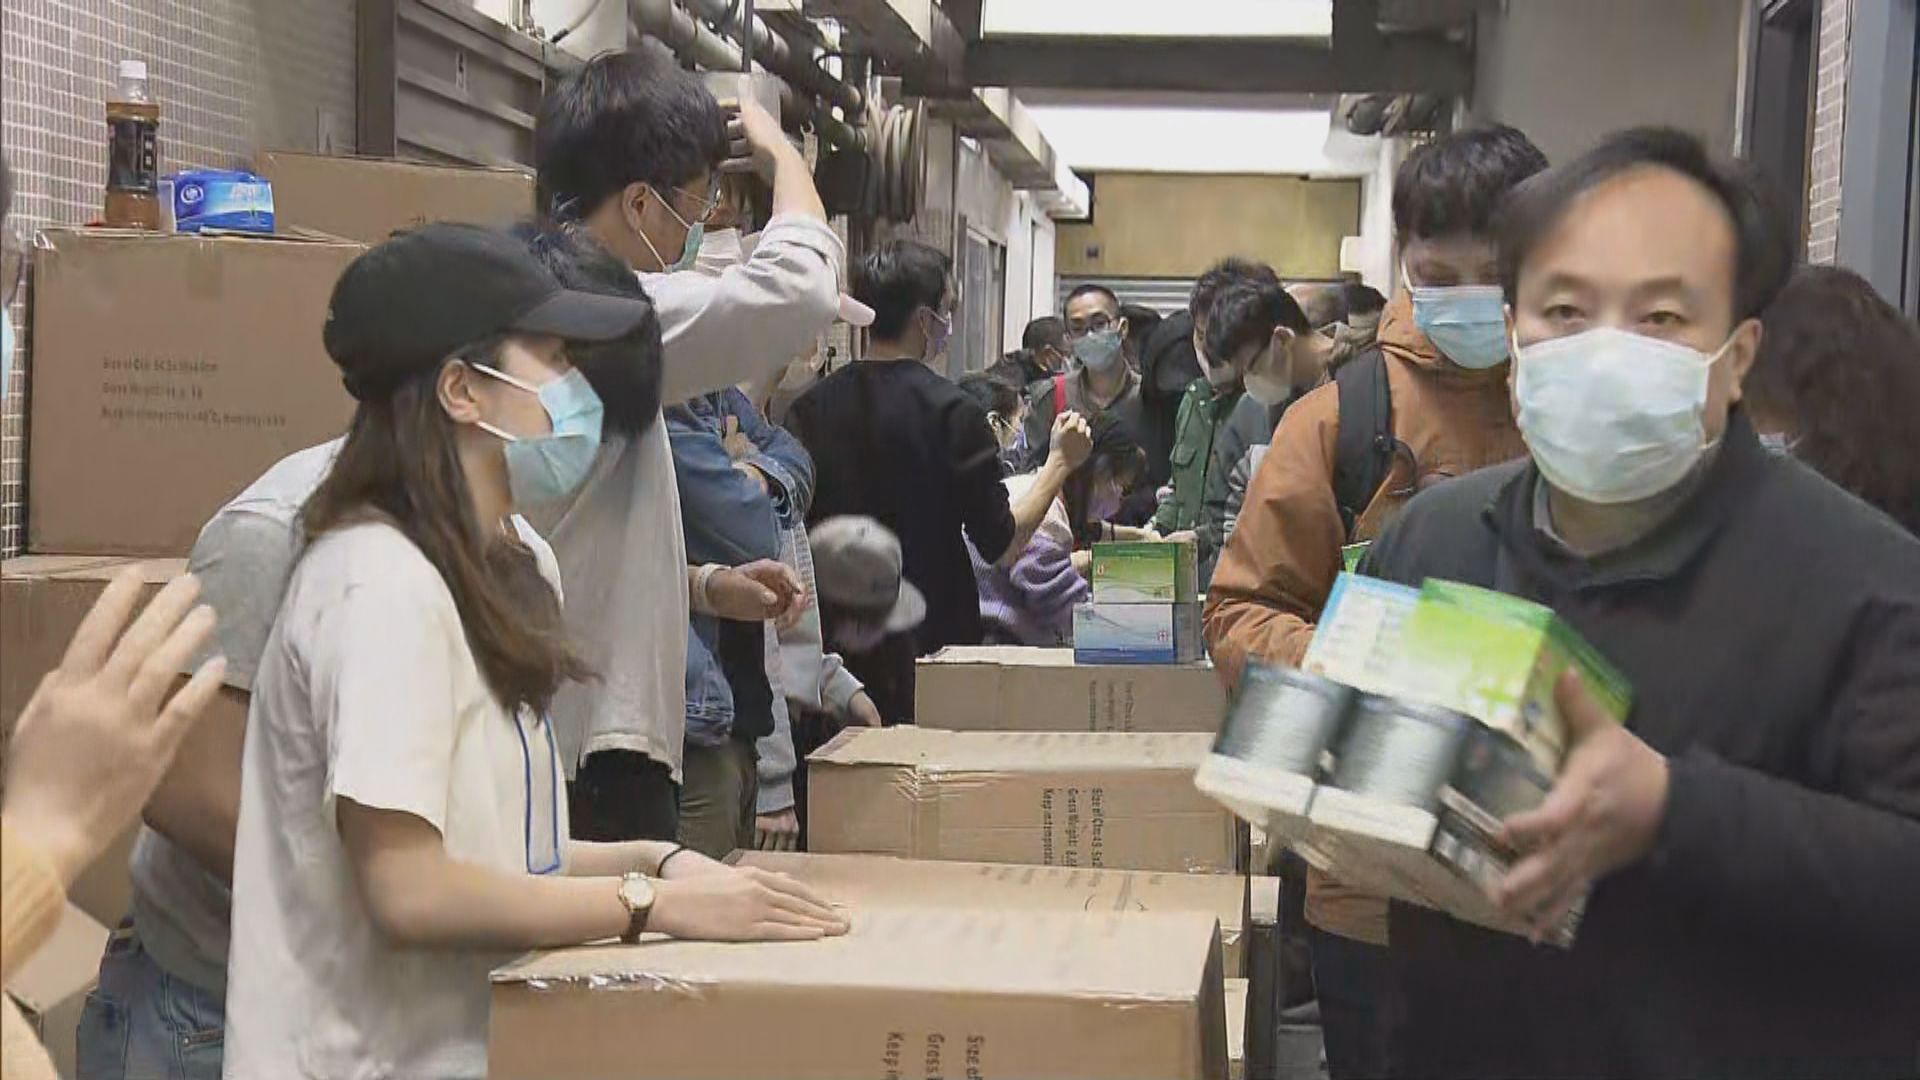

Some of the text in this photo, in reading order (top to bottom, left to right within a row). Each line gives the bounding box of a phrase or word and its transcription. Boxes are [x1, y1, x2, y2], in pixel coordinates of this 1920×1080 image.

[882, 1032, 905, 1066] Keep
[926, 1033, 945, 1073] Gross
[966, 1035, 985, 1064] Size
